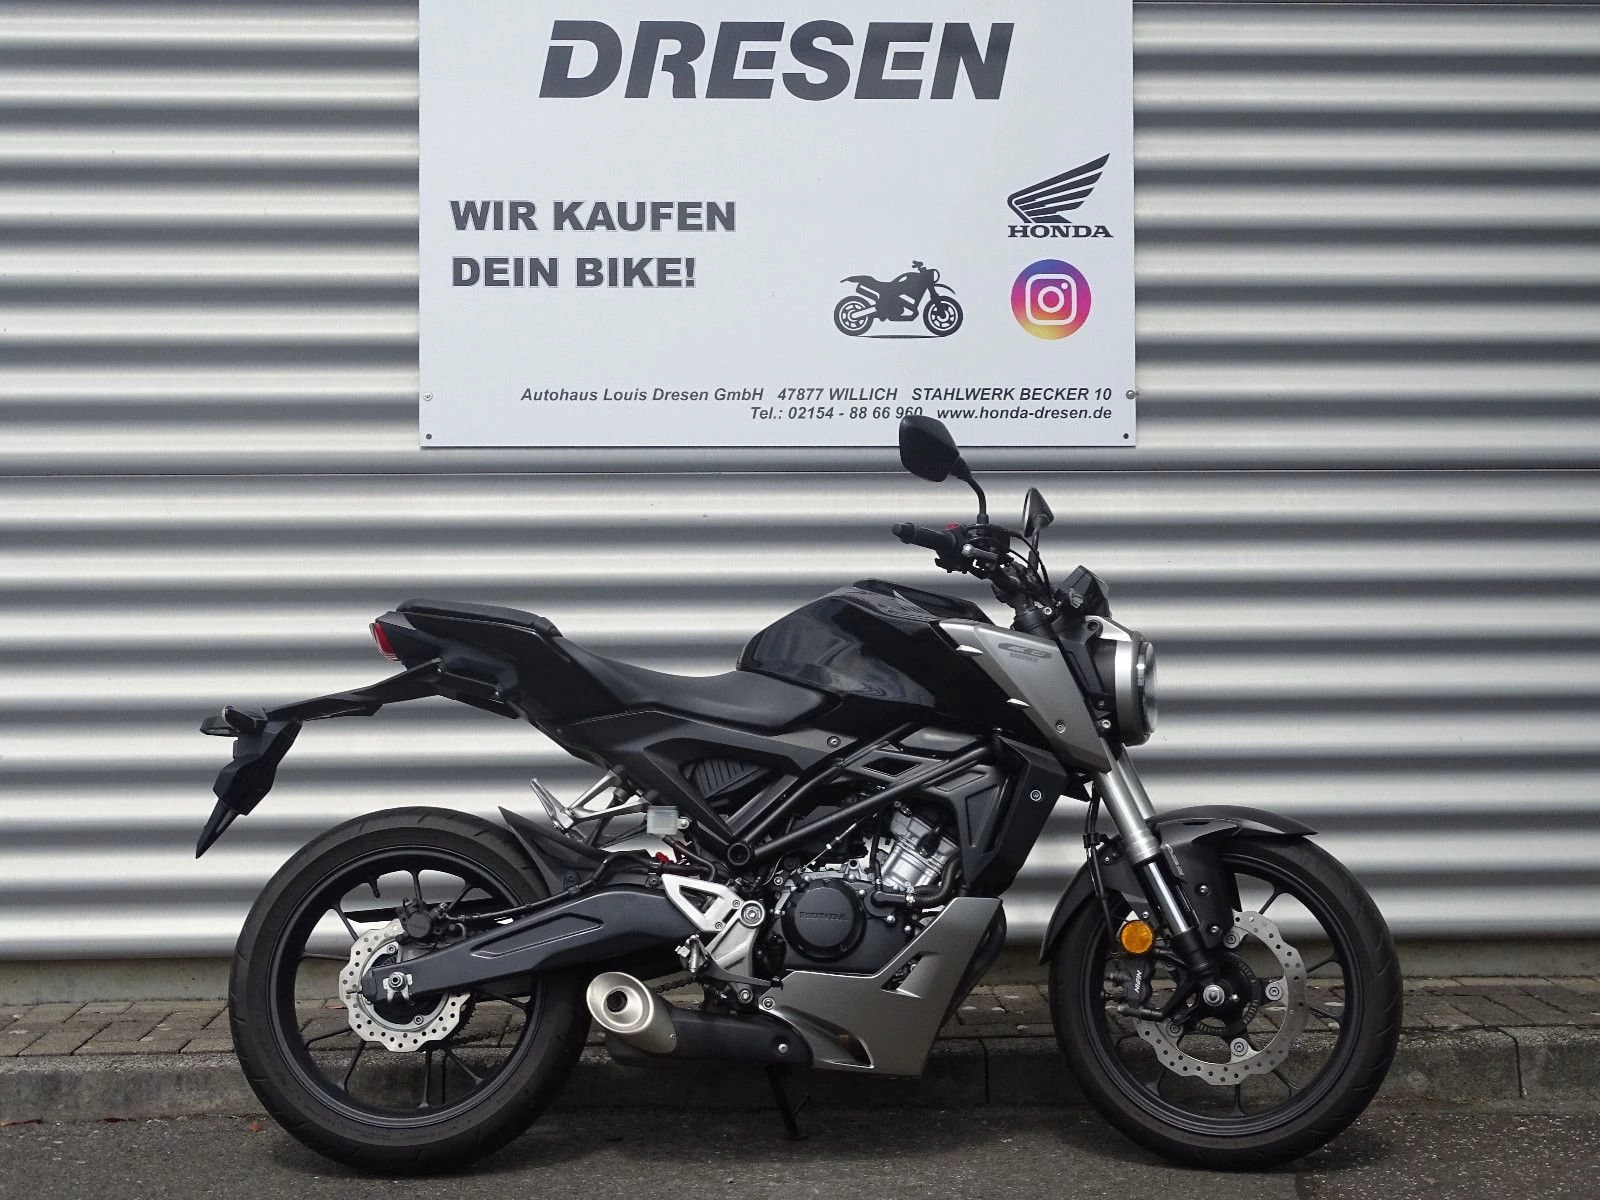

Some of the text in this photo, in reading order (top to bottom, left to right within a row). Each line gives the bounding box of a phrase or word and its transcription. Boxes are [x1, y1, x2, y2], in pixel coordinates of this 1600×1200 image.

[539, 20, 1014, 101] DRESEN
[450, 200, 736, 232] WIR KAUFEN
[1007, 220, 1114, 239] HONDA
[452, 257, 696, 288] DEIN BIKE!
[520, 387, 1112, 401] Autohaus Louis Dresen GmbH 47877 WILLICH STAHLWERK BECKER 10
[750, 406, 783, 420] Tel.:
[788, 406, 834, 420] 02154
[849, 406, 868, 420] 88
[872, 406, 891, 420] 66
[936, 406, 1112, 420] www.honda-dresen.de
